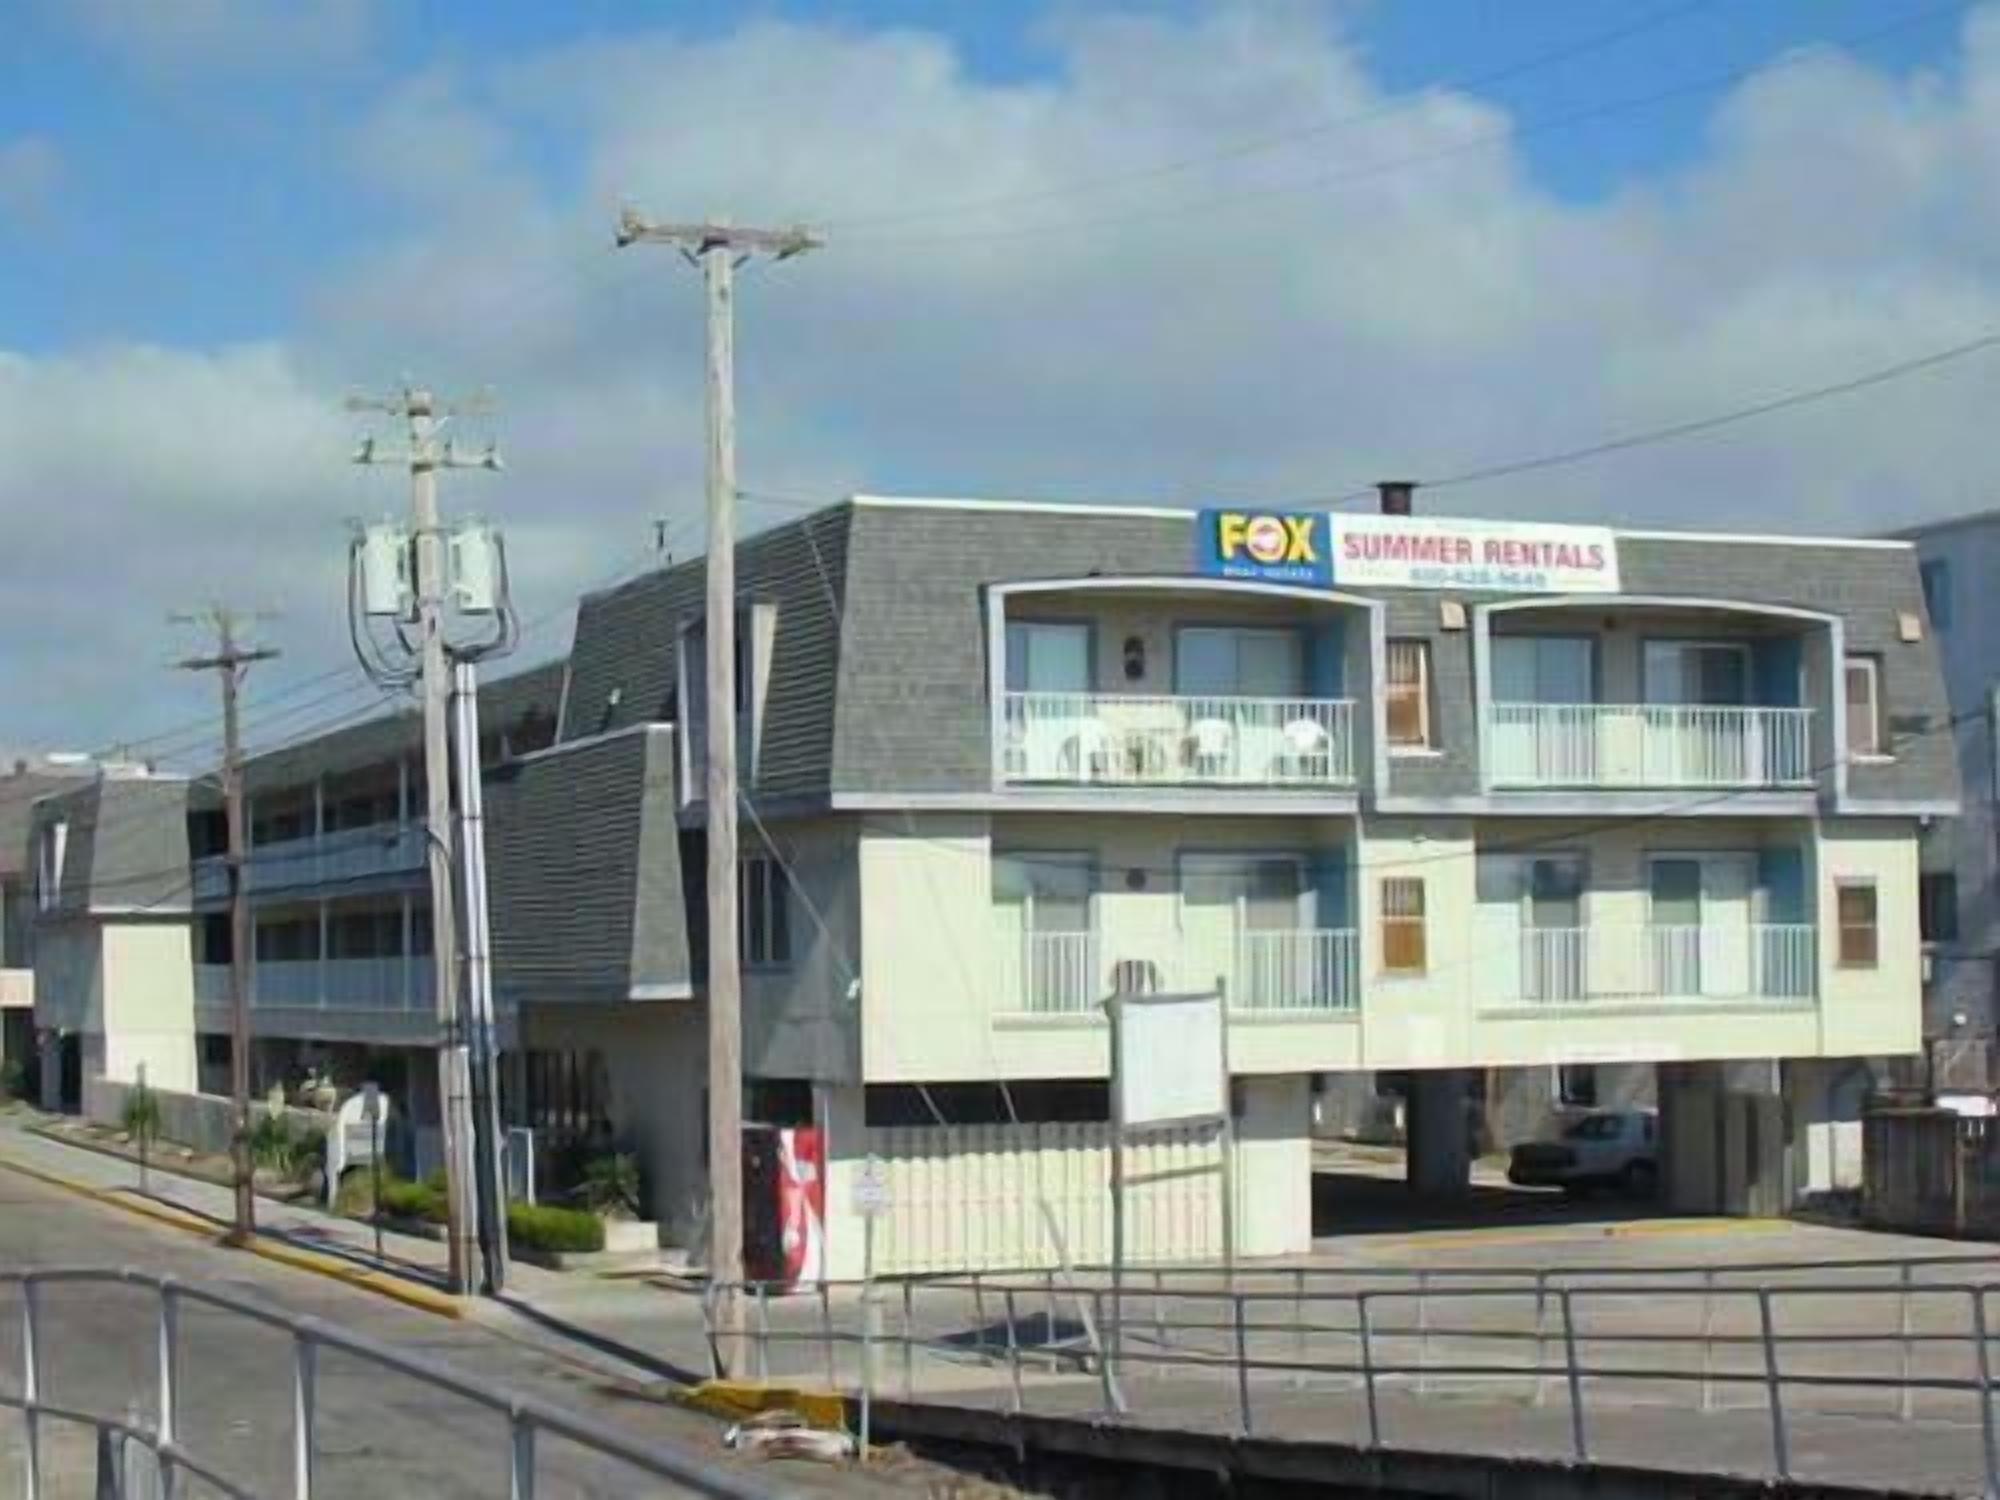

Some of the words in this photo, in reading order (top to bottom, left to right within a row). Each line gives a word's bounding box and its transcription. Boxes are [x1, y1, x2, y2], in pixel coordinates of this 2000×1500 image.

[1220, 513, 1316, 562] FOX
[1344, 533, 1472, 564] SUMMER
[1483, 540, 1605, 570] RENTALS
